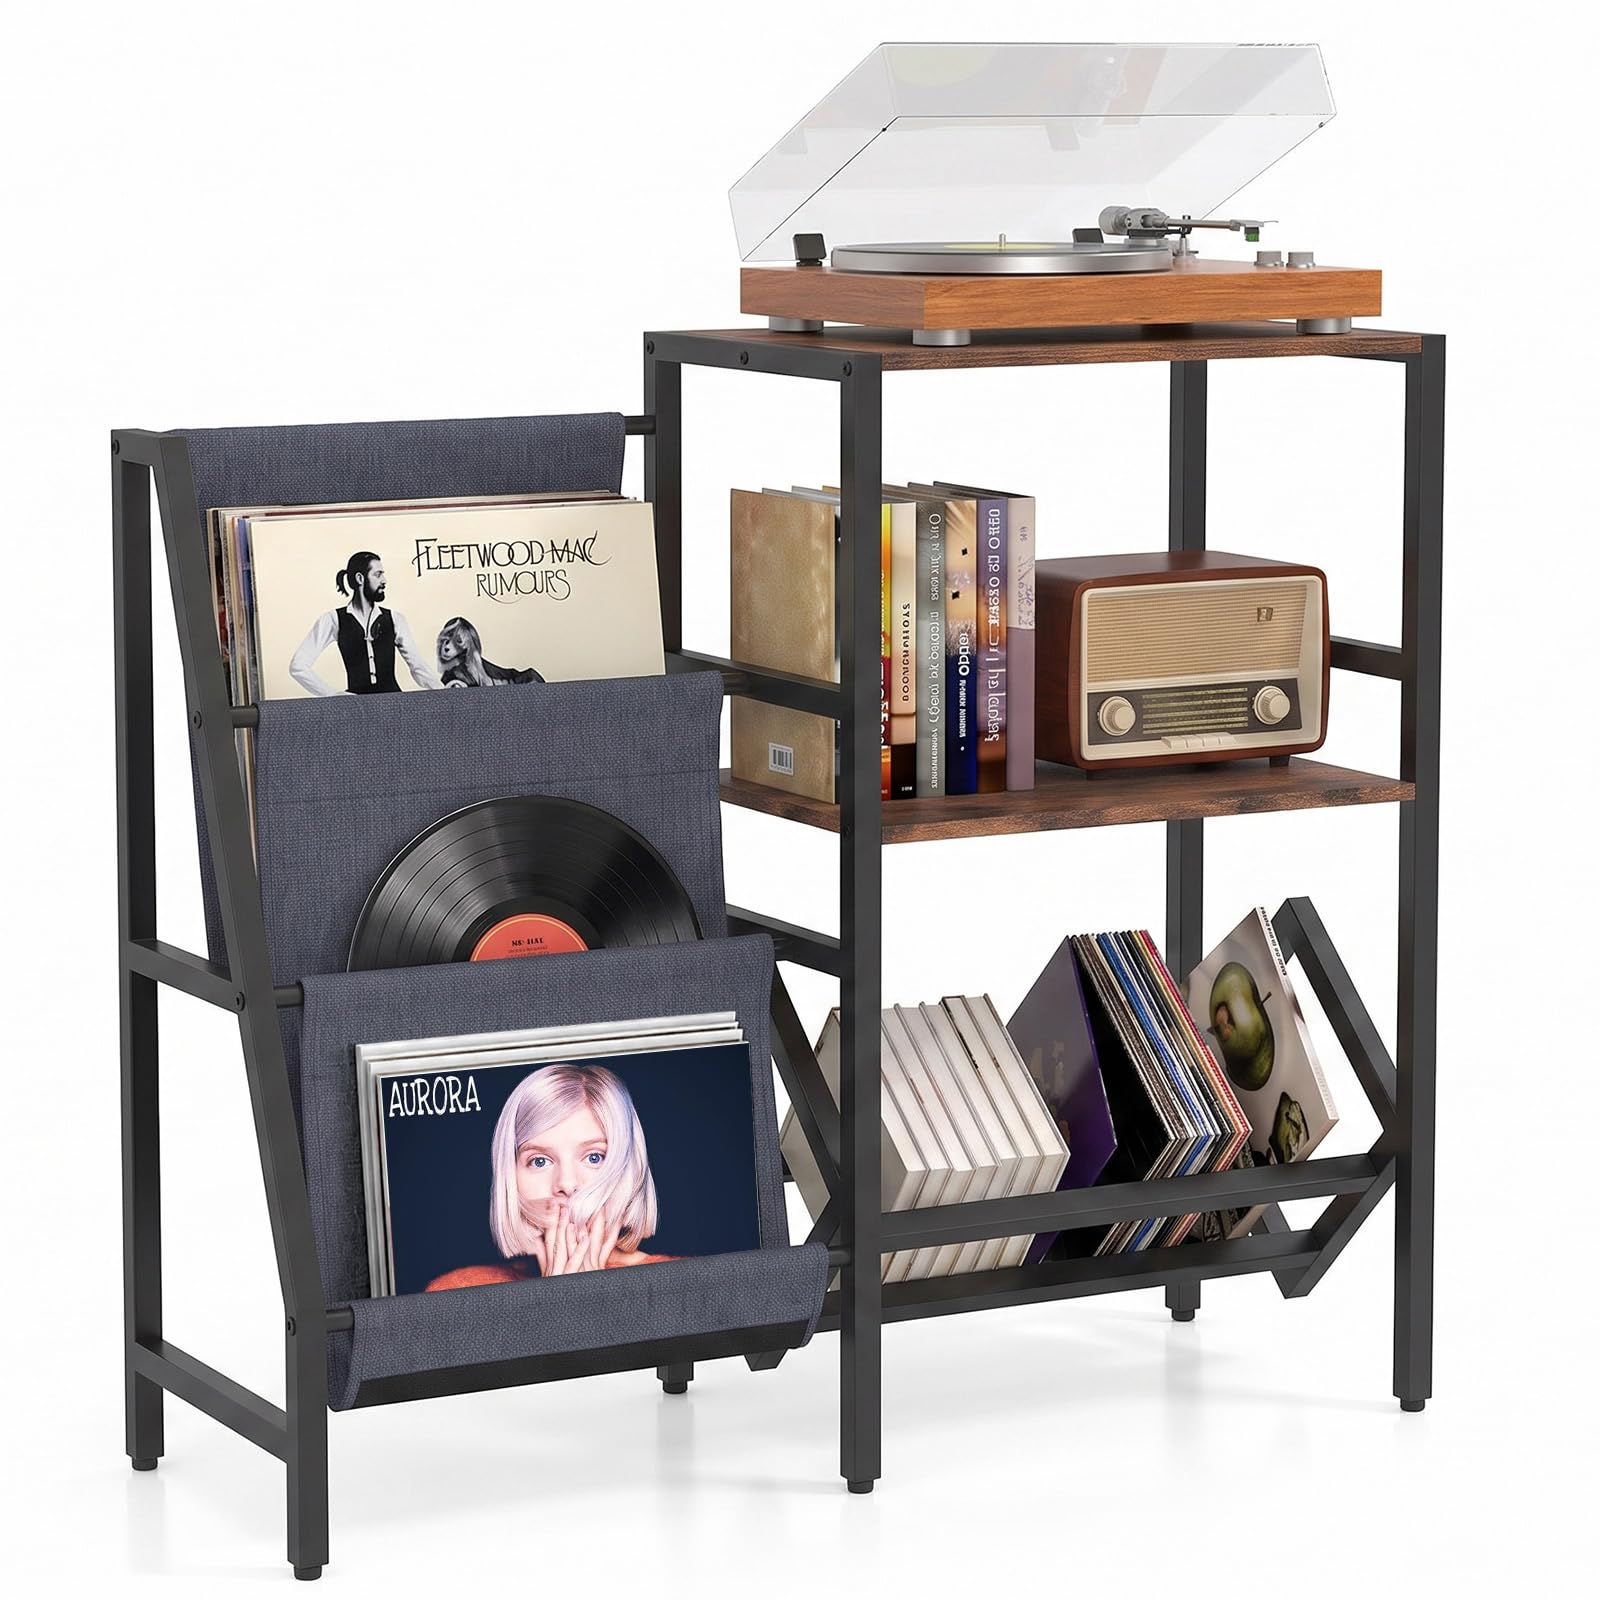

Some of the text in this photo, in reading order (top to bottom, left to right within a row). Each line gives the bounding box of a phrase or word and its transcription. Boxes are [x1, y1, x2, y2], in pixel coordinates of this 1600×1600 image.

[412, 530, 613, 577] FLEETWOOD MAC
[475, 568, 572, 604] RUMOURS
[389, 1076, 481, 1117] AURORA
